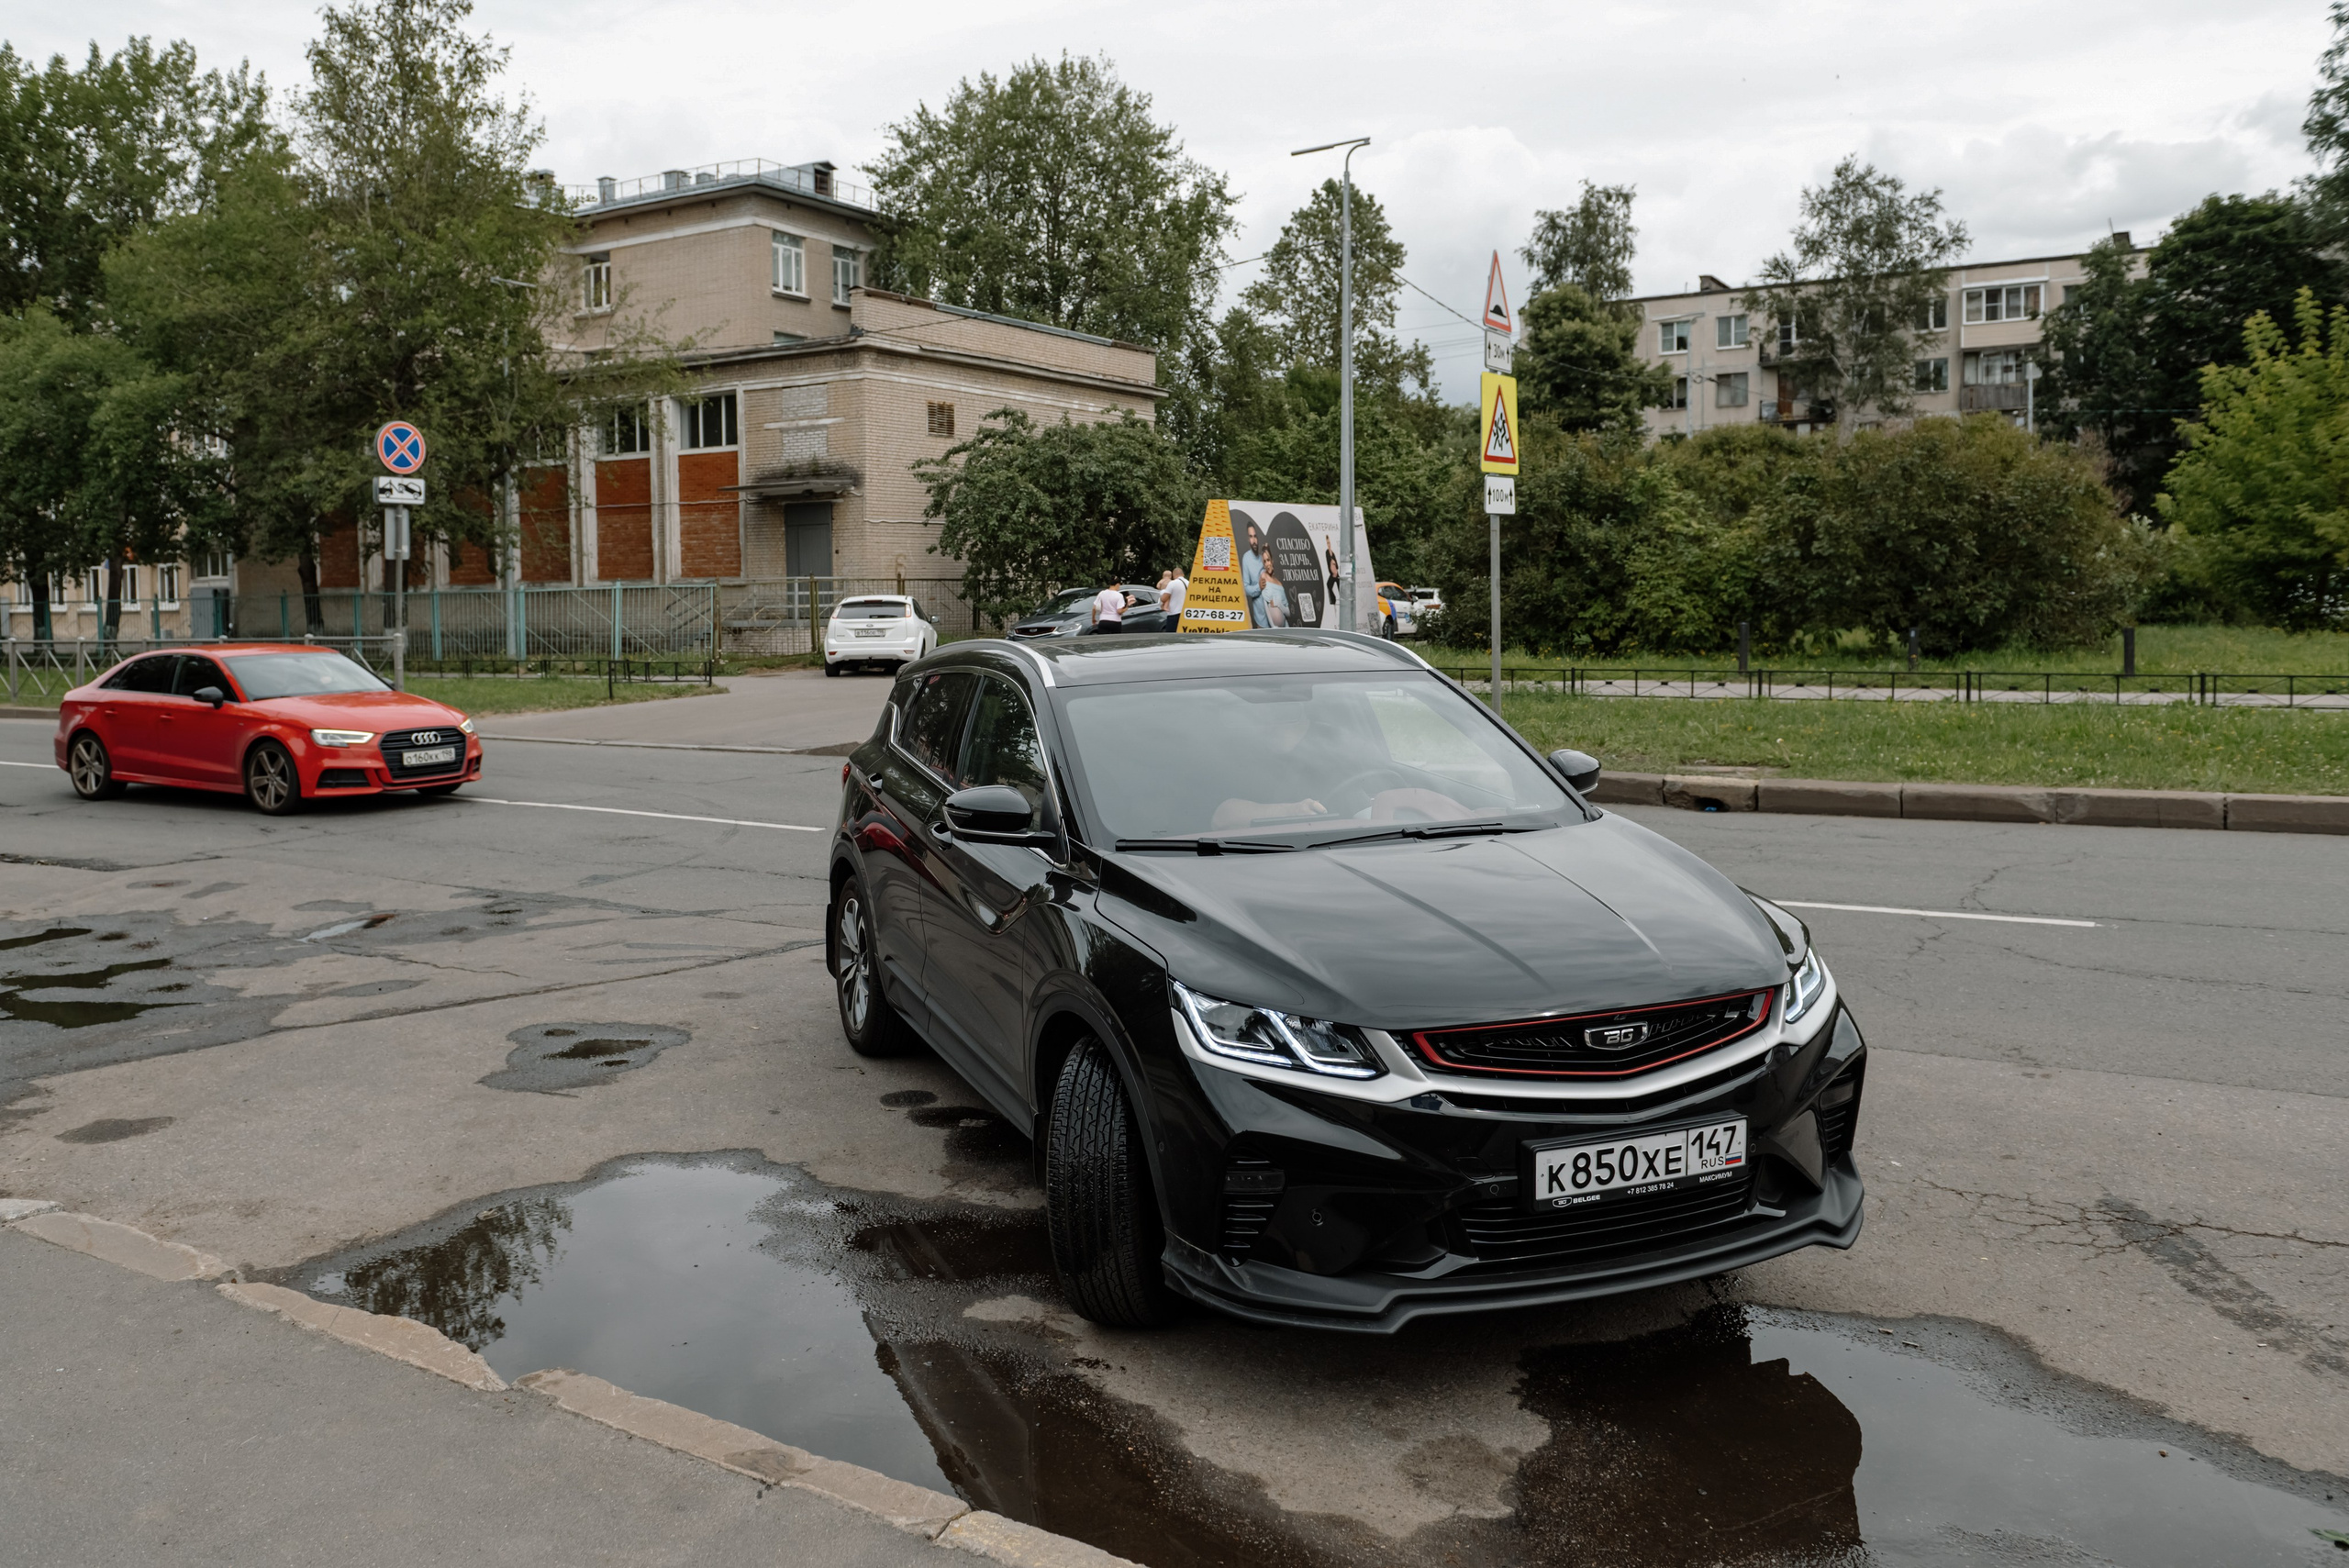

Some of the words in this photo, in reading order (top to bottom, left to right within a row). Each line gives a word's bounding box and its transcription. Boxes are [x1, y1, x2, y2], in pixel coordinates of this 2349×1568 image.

[1492, 489, 1508, 503] 100м
[1308, 522, 1339, 531] ЕКАТЕРИНА
[1276, 538, 1311, 550] СПАСИБО
[1279, 553, 1289, 566] ЗА
[1290, 553, 1312, 567] ДОЧЬ,
[1193, 577, 1239, 585] РЕКЛАМА
[1283, 569, 1319, 581] ЛЮБИМАЯ
[1189, 595, 1241, 603] ПРИЦЕПАХ
[1185, 609, 1243, 620] 627-68-27
[1604, 1029, 1633, 1044] BG
[1548, 1145, 1682, 1194] К850ХЕ
[1691, 1125, 1737, 1159] 147
[1701, 1156, 1724, 1169] RUS
[1698, 1171, 1733, 1183] МАКСИМУМ
[1573, 1195, 1600, 1204] BELGEE
